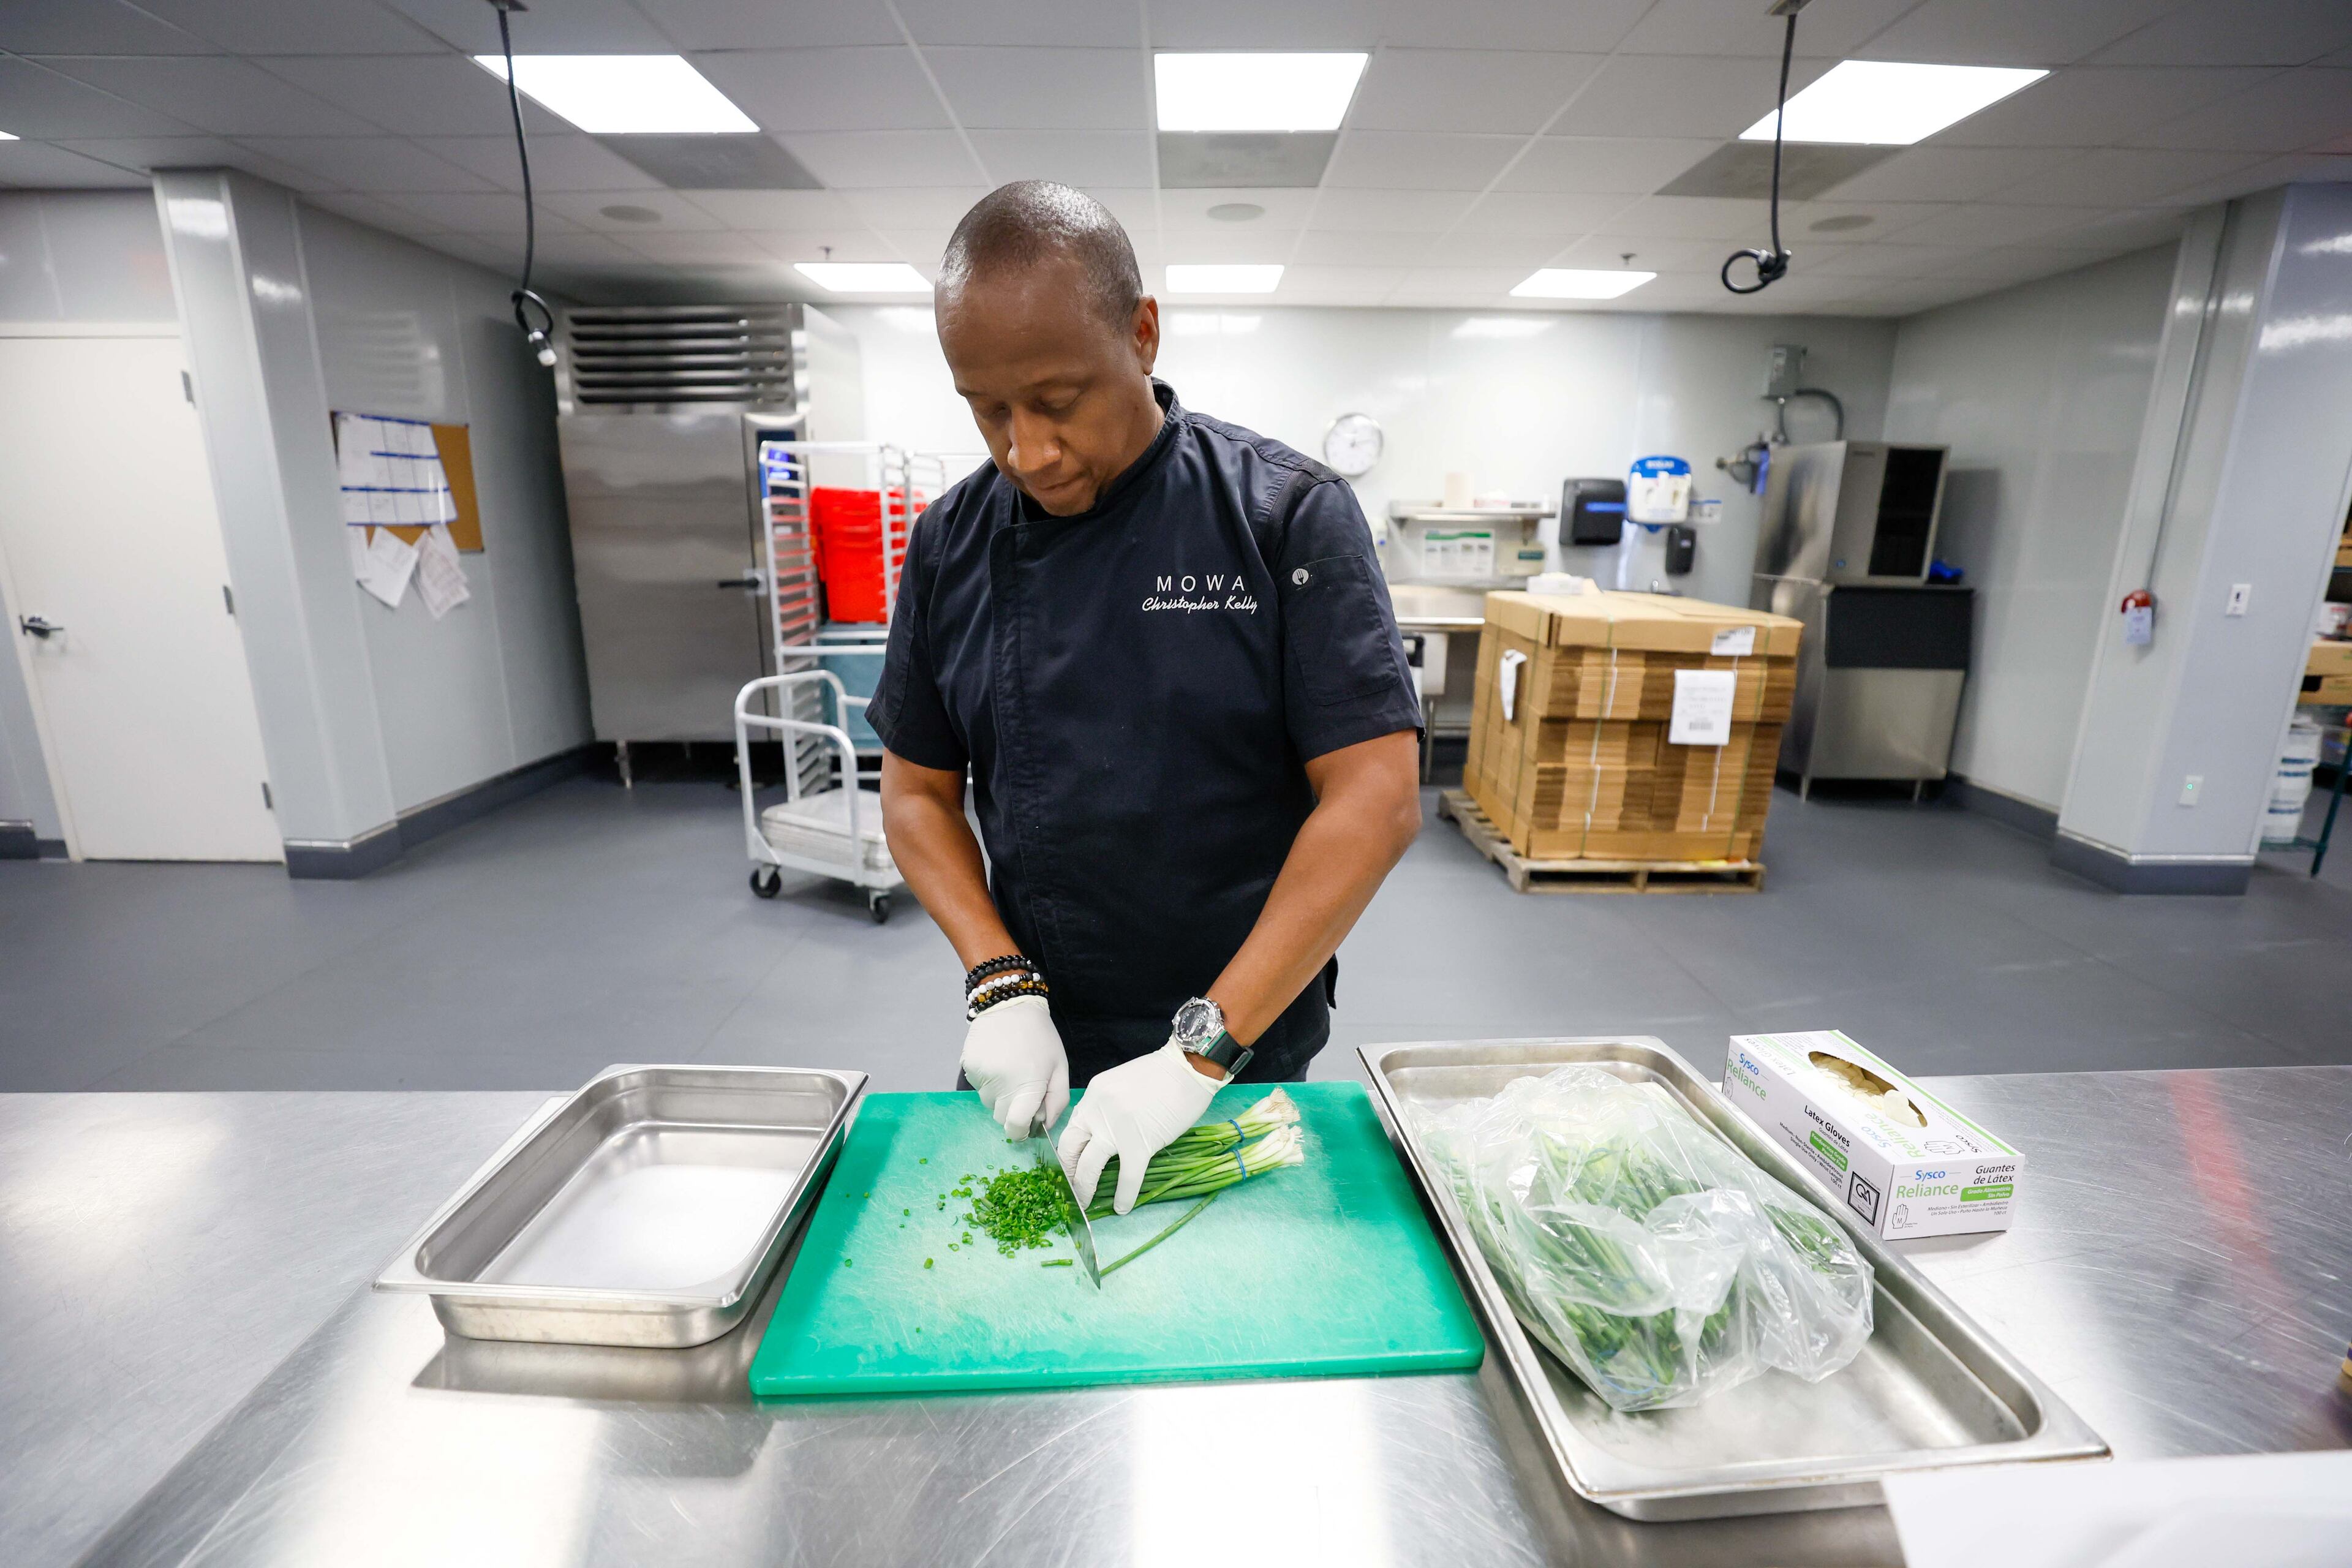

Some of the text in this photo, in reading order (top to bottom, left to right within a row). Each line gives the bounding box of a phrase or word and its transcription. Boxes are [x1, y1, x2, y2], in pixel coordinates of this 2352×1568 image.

[1156, 574, 1245, 592] MOWA
[1142, 595, 1257, 615] Christopher Kelly
[1739, 1053, 1759, 1076] Sysco
[1727, 1058, 1766, 1101] Reliance
[1804, 1105, 1850, 1147] Latex Gloves
[1819, 1128, 1833, 1141] Guantes
[1866, 1112, 1926, 1158] Reliance
[1861, 1126, 1891, 1148] Sysco
[1956, 1135, 1982, 1153] Sysco
[1779, 1121, 1843, 1178] Medium Non-Sterile Ambidextrous
[1834, 1151, 1846, 1164] Grade
[1790, 1136, 1801, 1148] Single
[1808, 1152, 1817, 1163] Only
[1819, 1161, 1829, 1172] Wrist
[1829, 1169, 1842, 1184] Length
[1975, 1164, 2016, 1174] Guantes
[1915, 1170, 1946, 1182] Sysco
[1973, 1174, 2014, 1185] de Látex
[1896, 1183, 1959, 1199] Reliance
